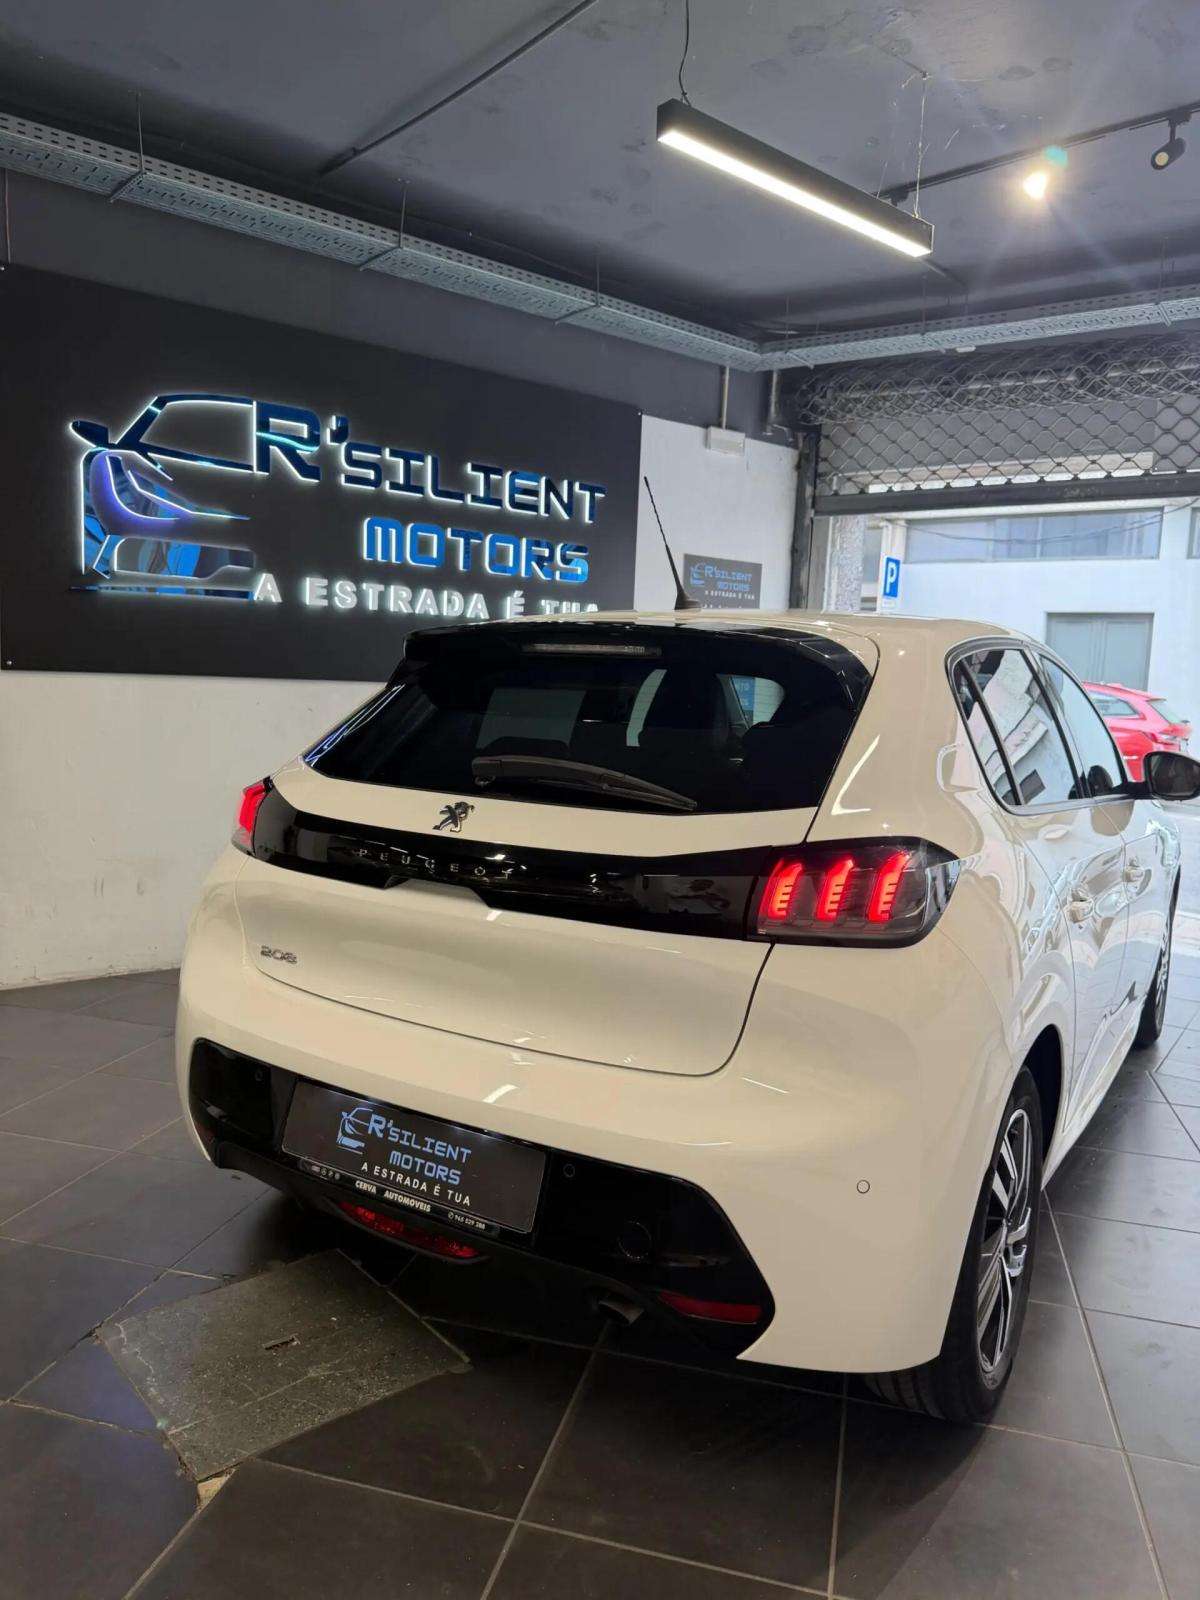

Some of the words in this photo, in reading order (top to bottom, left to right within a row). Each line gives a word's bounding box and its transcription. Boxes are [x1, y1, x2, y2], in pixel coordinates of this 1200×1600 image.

[363, 515, 590, 583] MOTORS
[252, 572, 283, 604] A
[305, 576, 491, 622] ESTRADA
[505, 589, 526, 620] É
[886, 561, 897, 594] P
[354, 1180, 377, 1195] CERVA
[361, 1162, 369, 1173] A
[373, 1165, 428, 1193] ESTRADA
[433, 1183, 441, 1196] É
[448, 1190, 472, 1207] TUA
[388, 1150, 462, 1186] MOTORS
